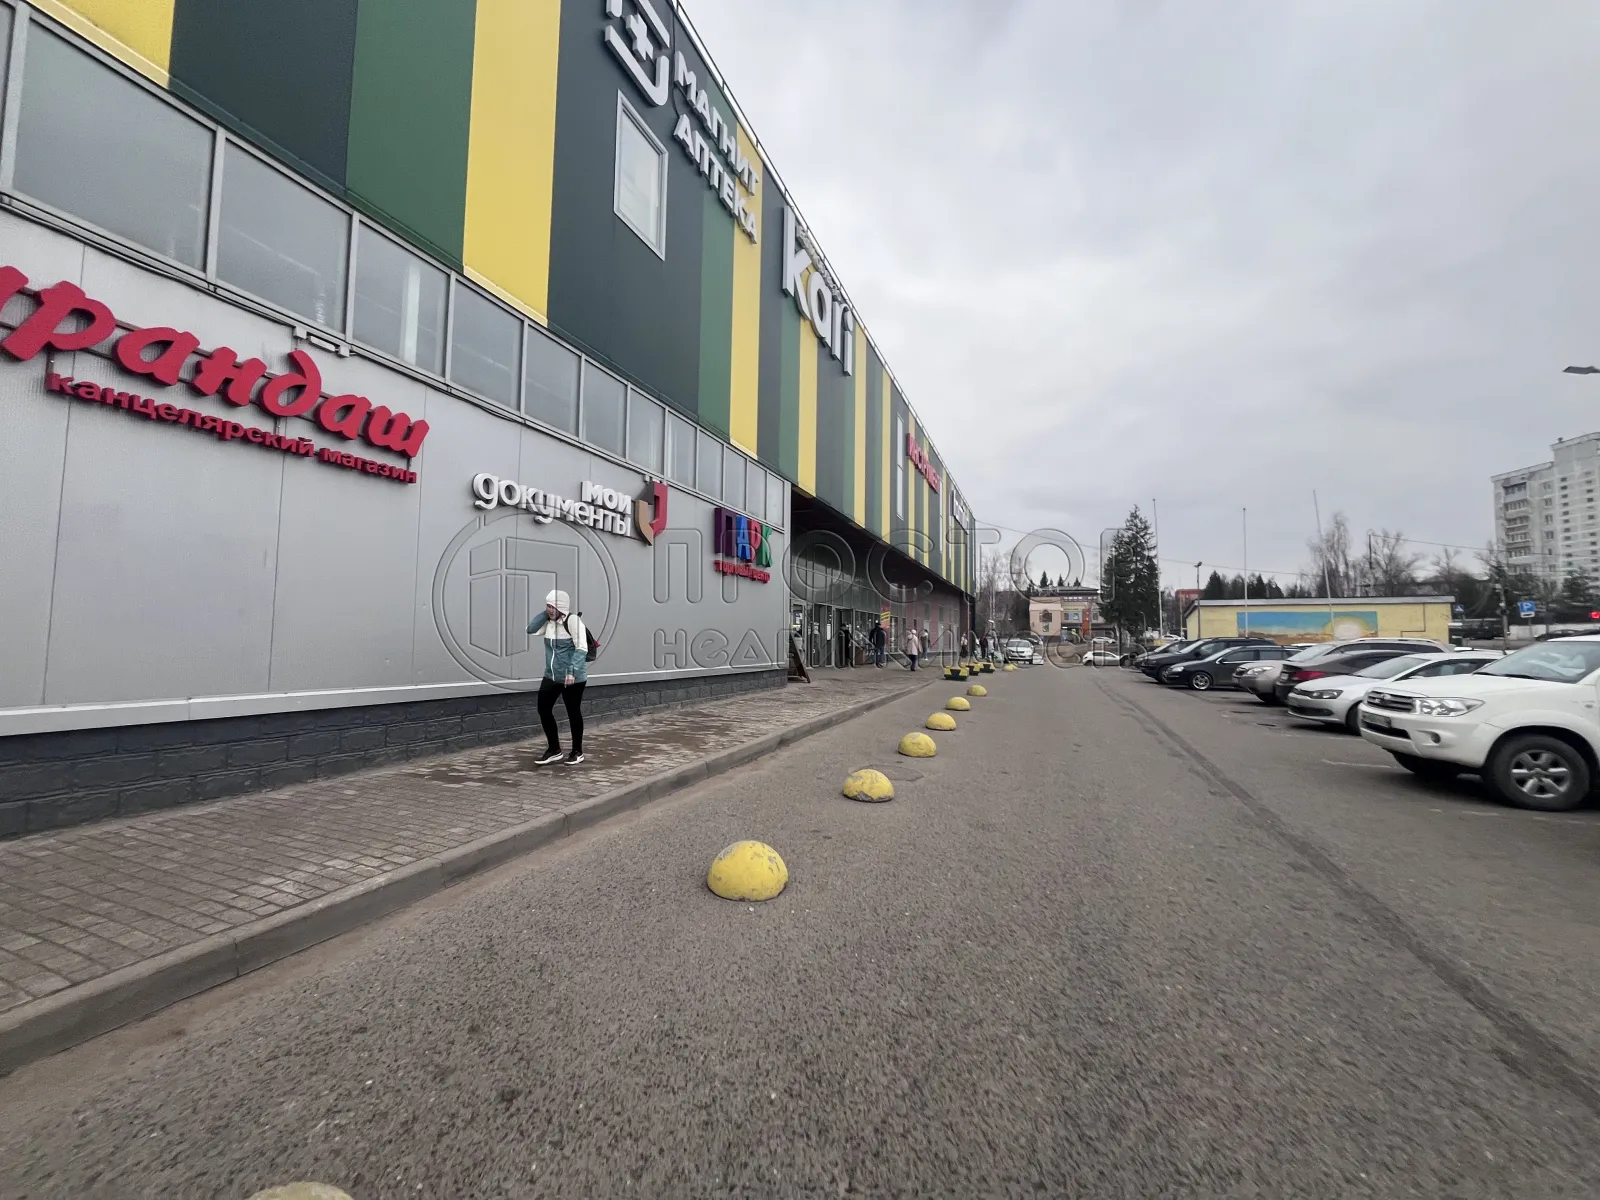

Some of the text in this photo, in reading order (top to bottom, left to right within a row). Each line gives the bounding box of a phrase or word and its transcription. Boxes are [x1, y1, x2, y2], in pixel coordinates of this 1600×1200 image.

[673, 113, 757, 244] АПТЕКА
[674, 51, 758, 196] МАГНИТ
[46, 373, 417, 484] канцелярский магазин
[473, 473, 632, 537] документы
[714, 507, 773, 567] ПАРК
